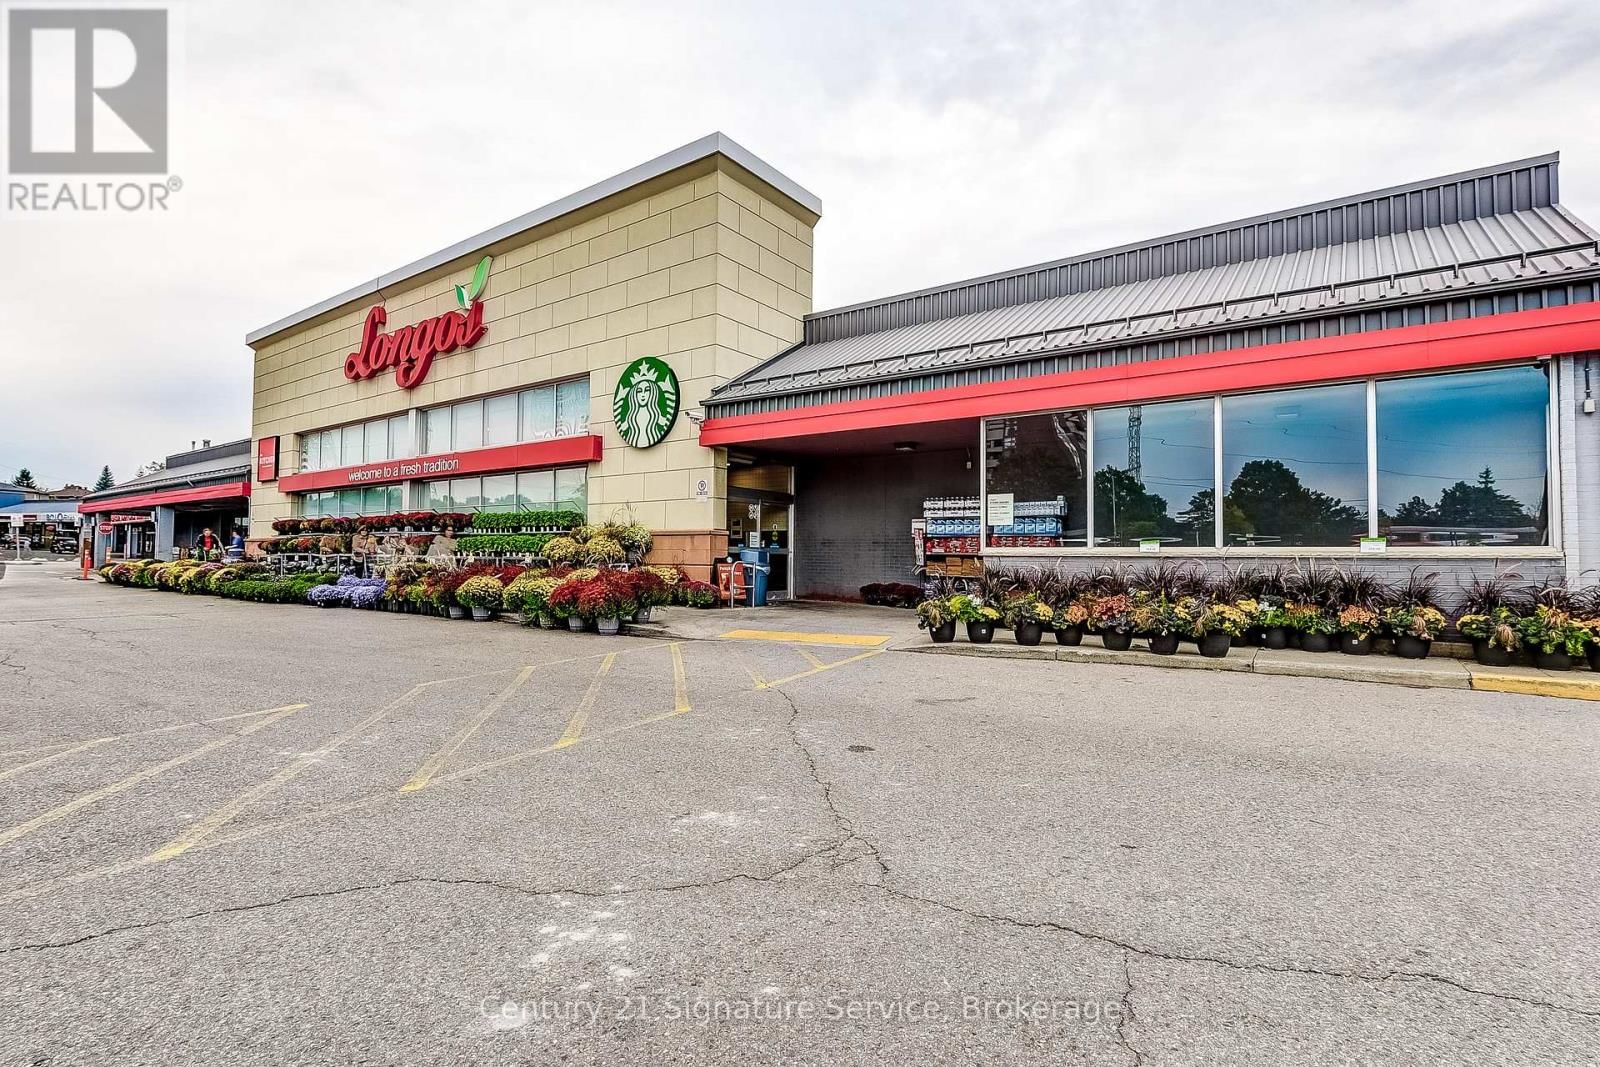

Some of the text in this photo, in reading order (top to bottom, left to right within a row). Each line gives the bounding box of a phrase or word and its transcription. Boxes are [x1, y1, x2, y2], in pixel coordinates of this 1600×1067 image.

[348, 458, 459, 482] welcome to a fresh tradition
